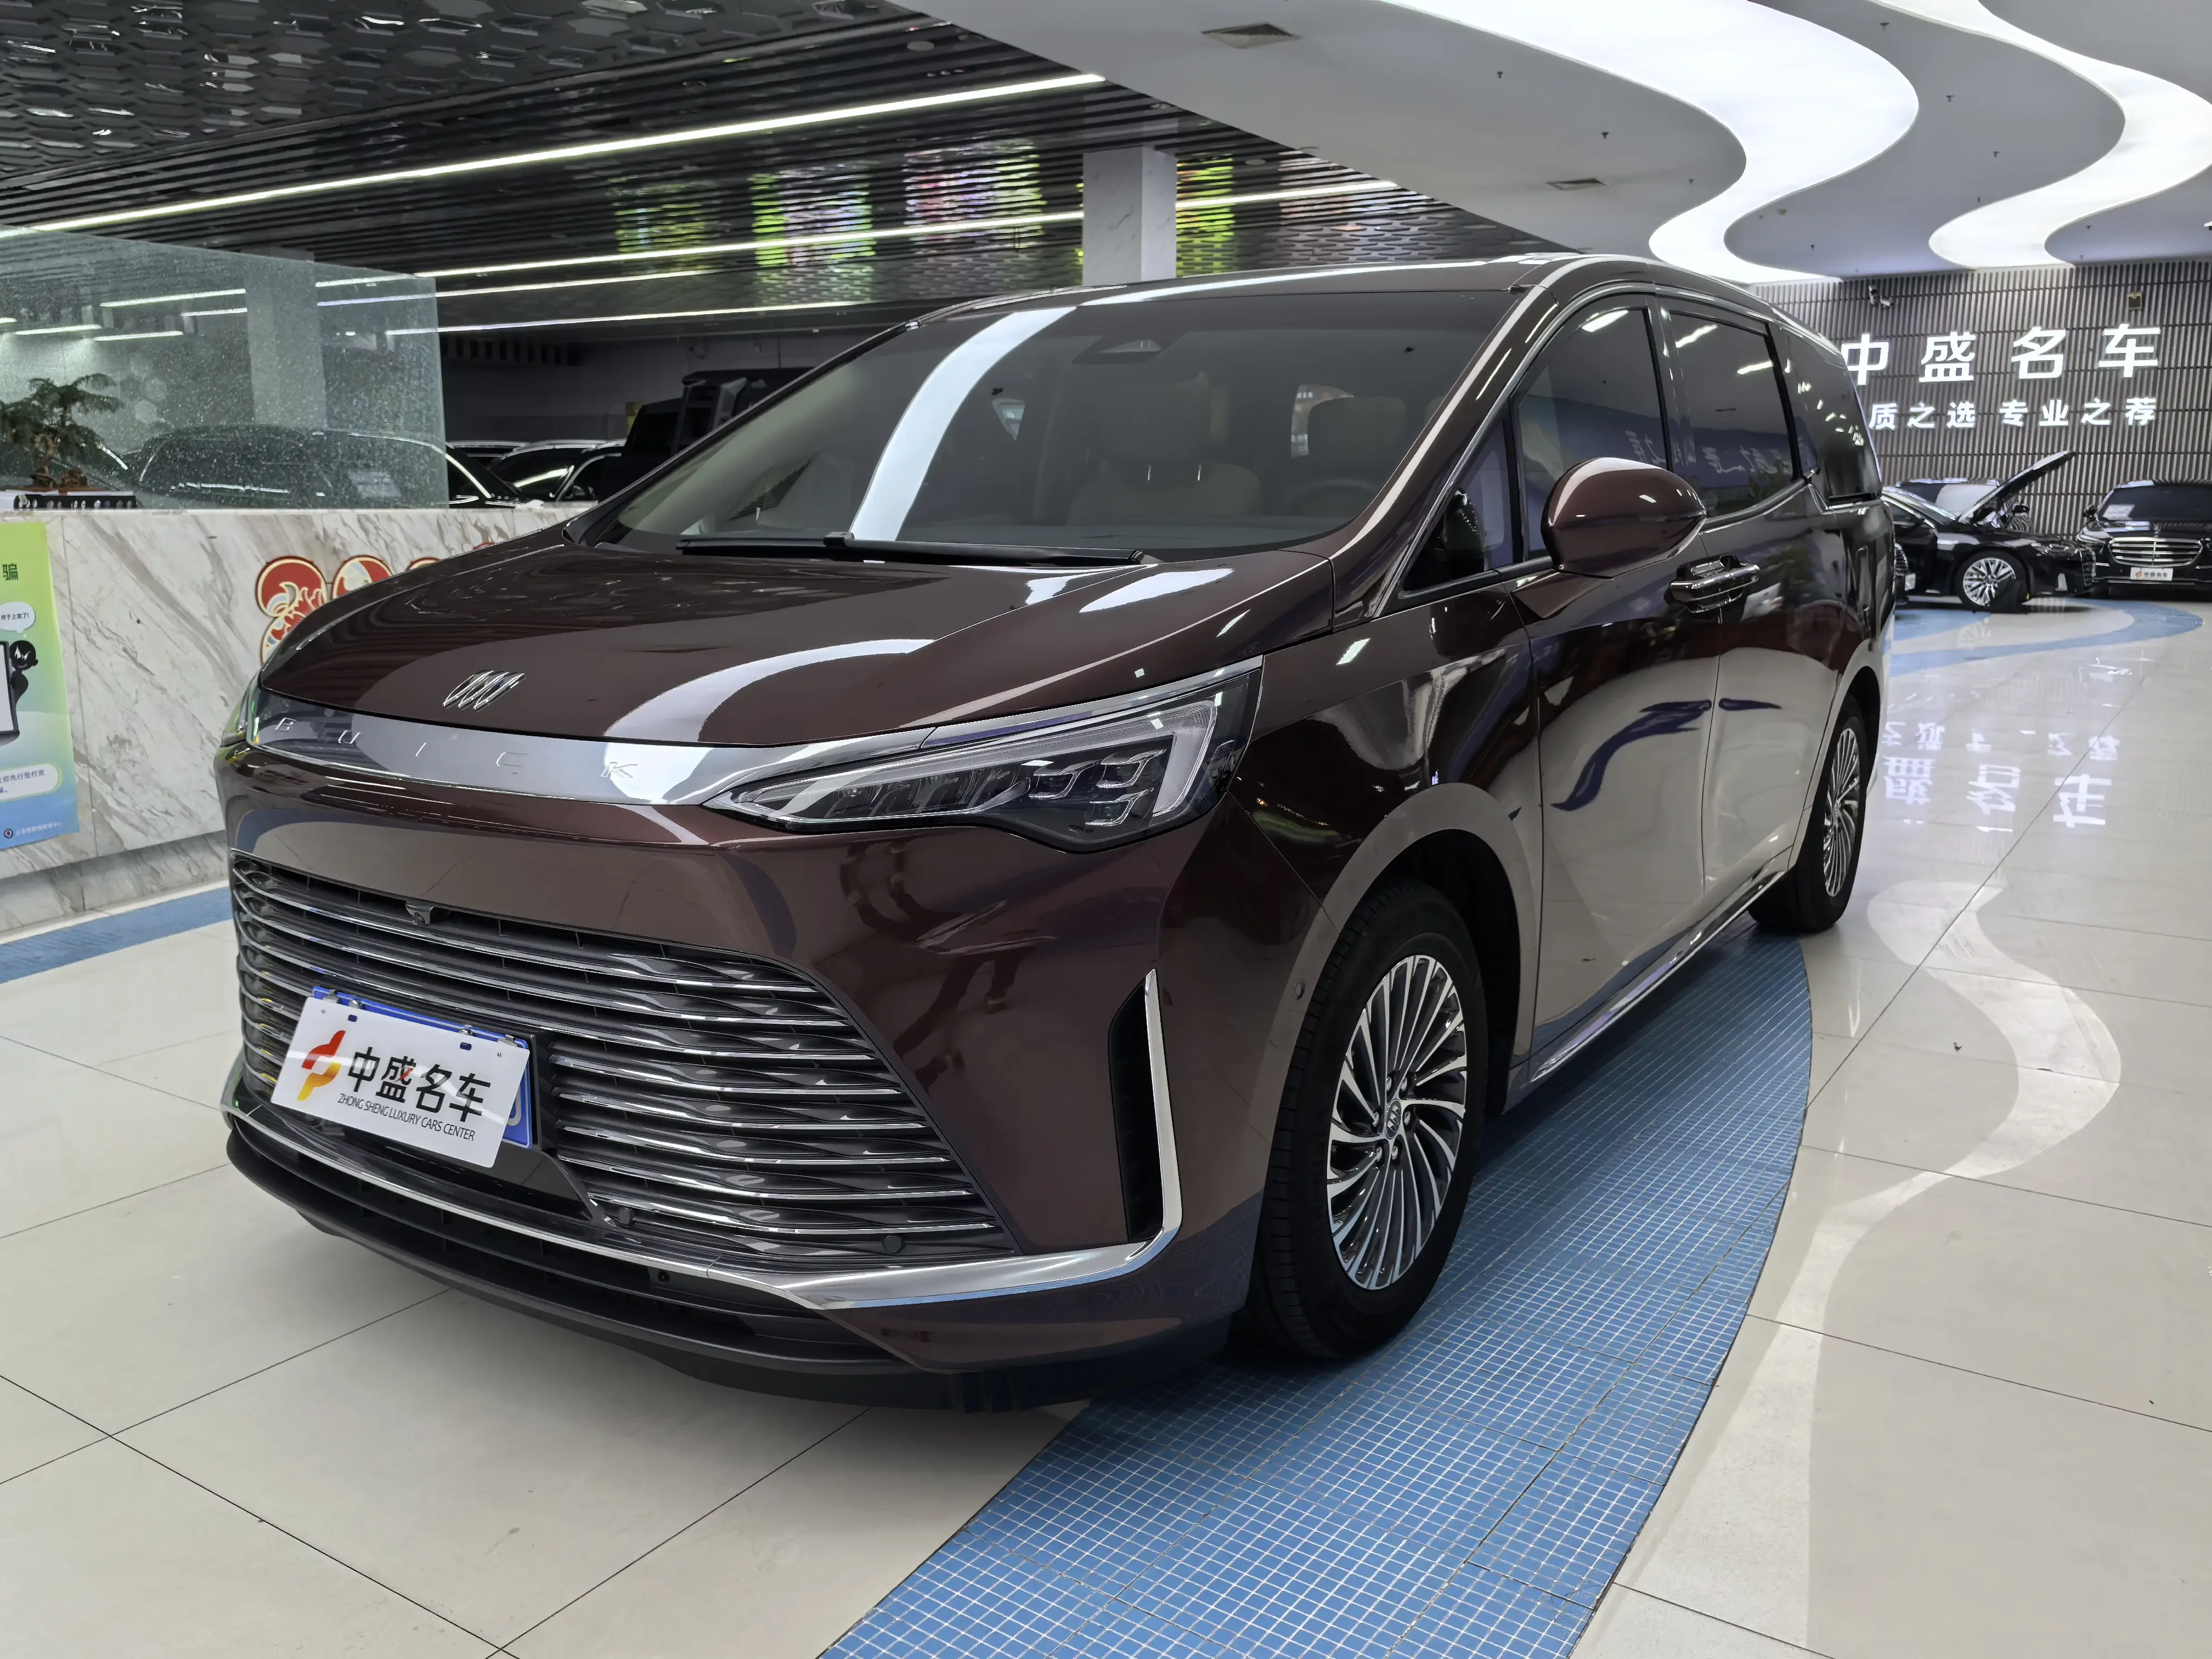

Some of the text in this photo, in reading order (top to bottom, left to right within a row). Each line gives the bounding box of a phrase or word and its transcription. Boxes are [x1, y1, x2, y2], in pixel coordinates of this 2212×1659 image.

[1841, 323, 2160, 385] 中盛名车
[1999, 397, 2157, 427] 专业之荐
[2, 563, 18, 581] 骗
[275, 717, 638, 778] BUICK
[347, 1047, 491, 1122] 中盛名车
[338, 1093, 475, 1141] ZHONG SHENG LUXURY CARS CENTER
